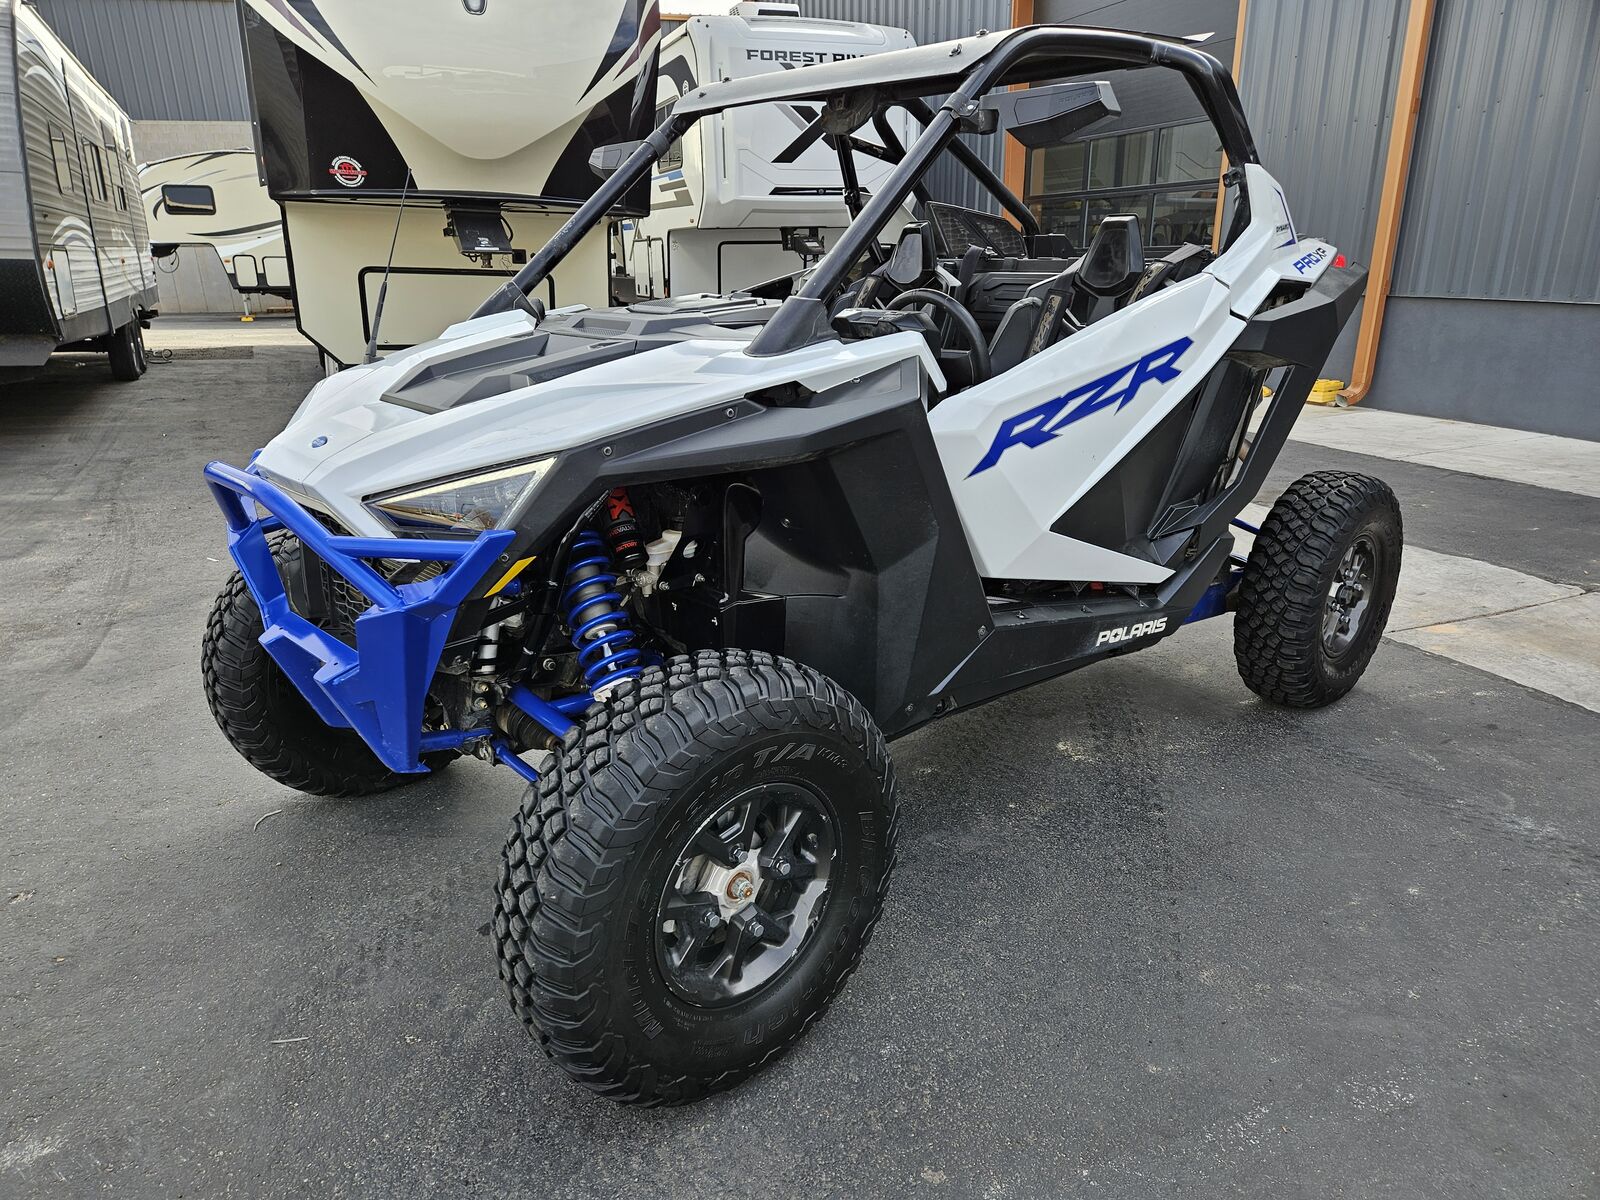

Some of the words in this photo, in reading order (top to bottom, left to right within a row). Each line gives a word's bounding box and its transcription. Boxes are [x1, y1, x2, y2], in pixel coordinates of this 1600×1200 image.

[746, 49, 827, 63] FOREST
[964, 336, 1193, 479] RZR
[1096, 617, 1168, 647] POLARIS
[753, 742, 817, 769] T/A
